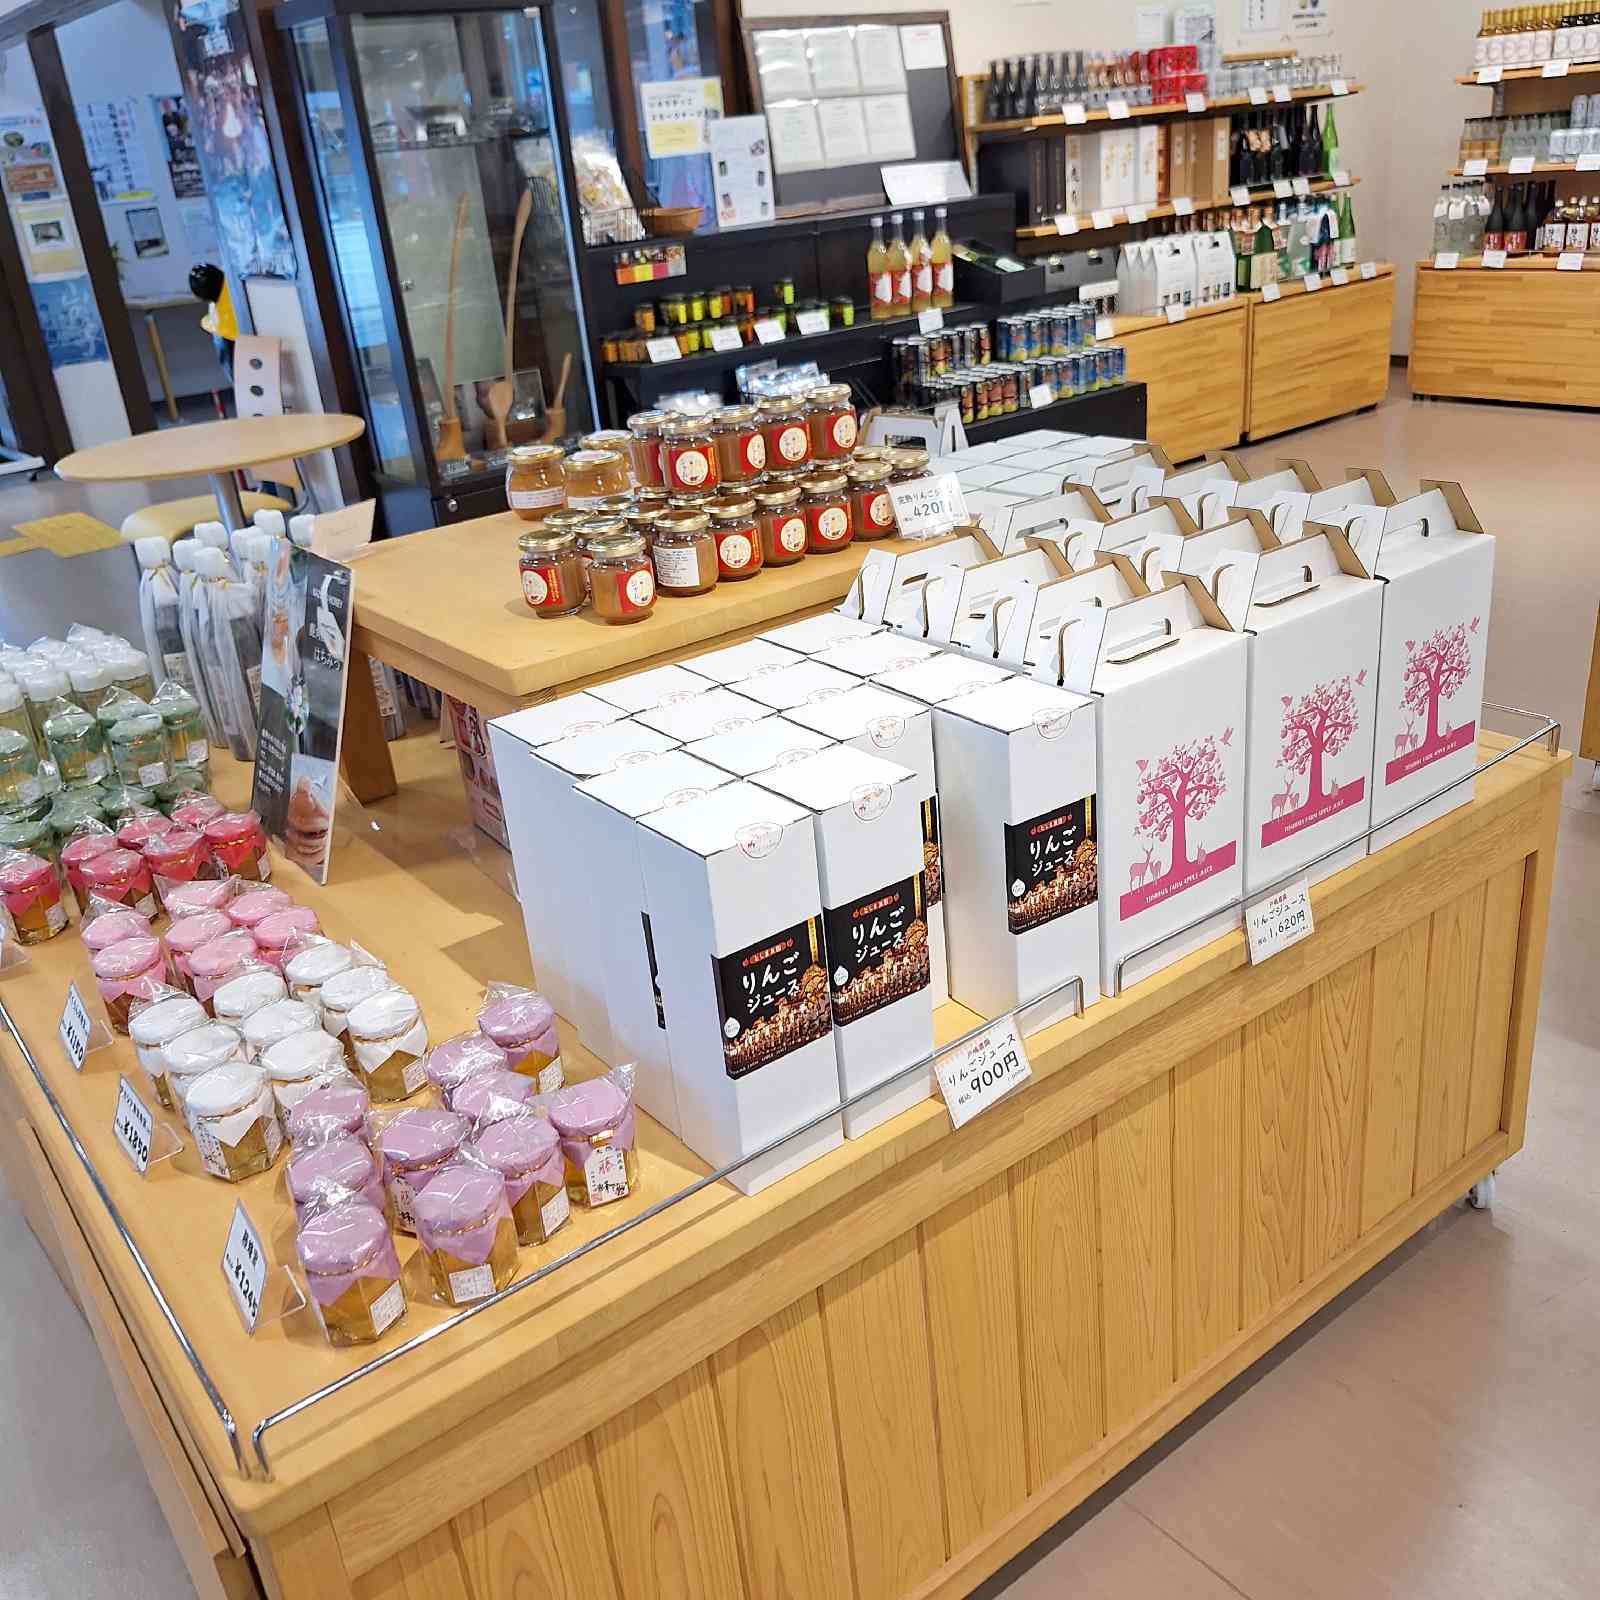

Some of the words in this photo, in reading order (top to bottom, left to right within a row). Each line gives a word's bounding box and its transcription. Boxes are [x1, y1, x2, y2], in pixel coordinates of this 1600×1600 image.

[1030, 825, 1077, 860] りんご
[1031, 850, 1075, 877] ジュース
[852, 905, 905, 945] りんご
[1253, 893, 1306, 928] りんごジュース
[1269, 910, 1305, 938] 1,620円
[855, 932, 904, 963] ジュース
[742, 951, 800, 995] りんご
[747, 978, 800, 1014] ジュース
[948, 1033, 1016, 1086] りんごジュース
[970, 1050, 1019, 1093] 900円
